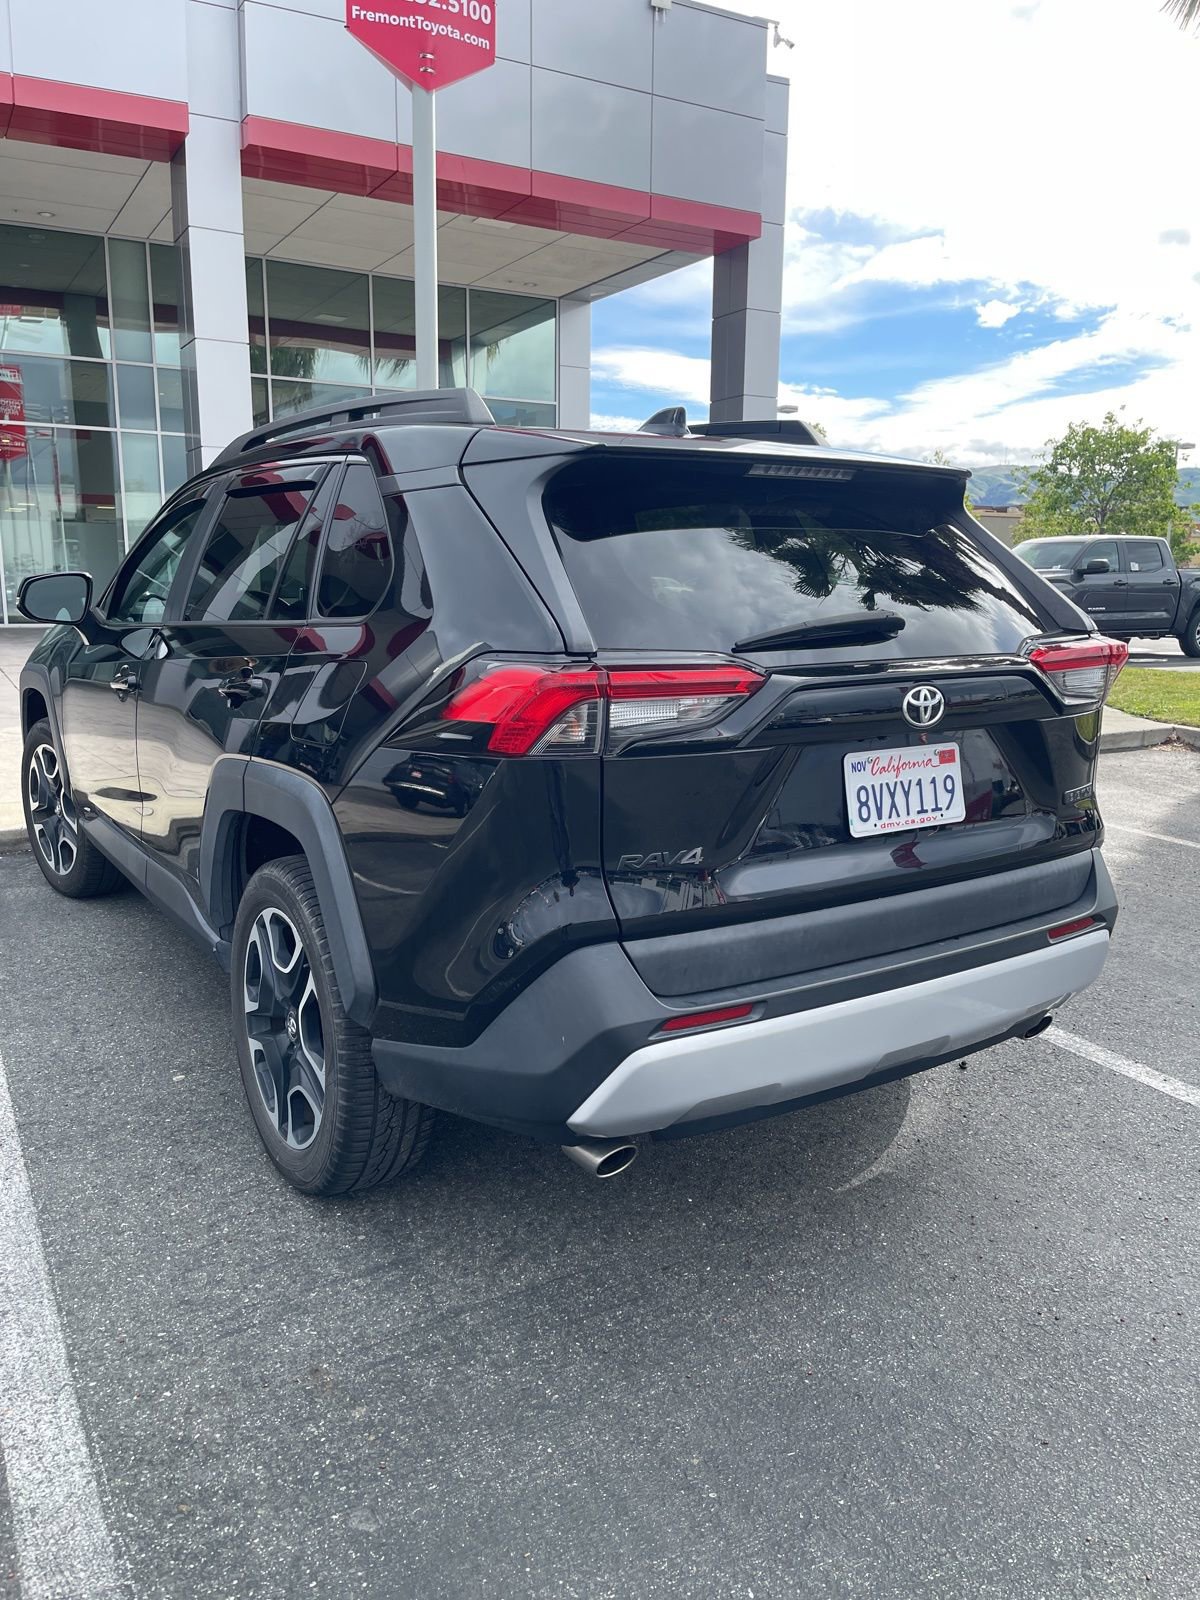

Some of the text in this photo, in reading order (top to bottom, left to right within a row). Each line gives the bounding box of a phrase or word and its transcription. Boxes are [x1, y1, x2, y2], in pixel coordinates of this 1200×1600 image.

[402, 0, 492, 25] .5100
[351, 5, 490, 50] FremontToyota.com
[851, 760, 867, 774] NOV
[870, 754, 940, 778] California
[856, 774, 956, 823] 8VXY119
[880, 815, 938, 829] dmv.ca.gov
[617, 846, 704, 871] RAV4
